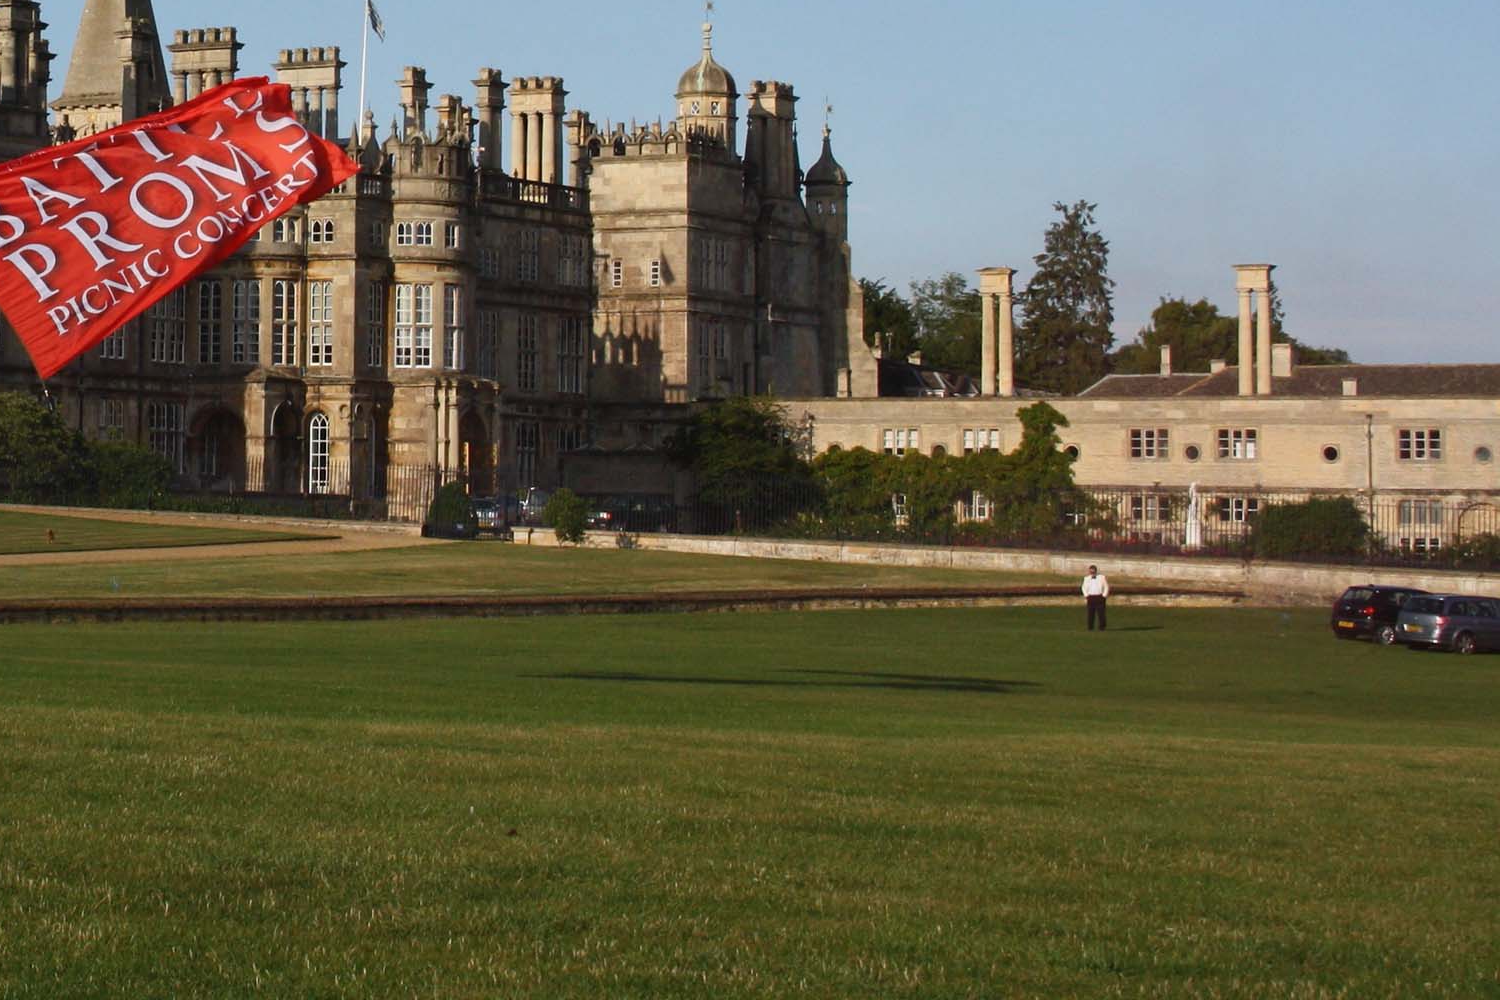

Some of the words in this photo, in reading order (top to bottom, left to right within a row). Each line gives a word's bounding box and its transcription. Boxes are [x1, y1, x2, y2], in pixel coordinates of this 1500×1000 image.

[3, 110, 310, 303] PROMS
[47, 249, 169, 336] PICNIC
[174, 150, 318, 260] CONCERT
